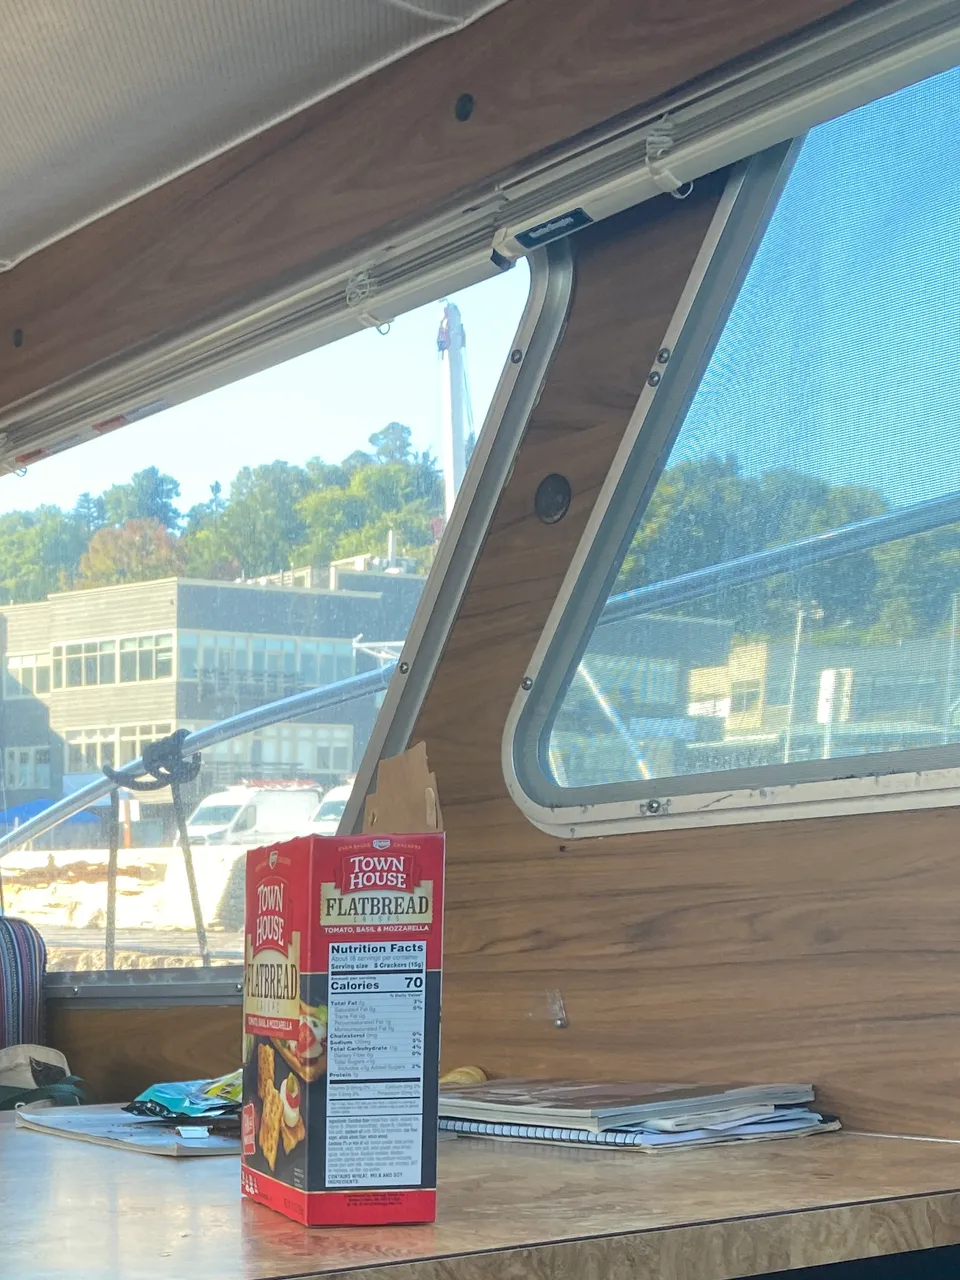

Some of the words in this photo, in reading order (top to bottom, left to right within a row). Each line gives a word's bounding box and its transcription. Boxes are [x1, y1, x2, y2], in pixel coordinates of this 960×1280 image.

[350, 856, 405, 873] TOWN
[349, 872, 407, 889] HOUSE
[258, 883, 284, 914] TOWN
[325, 895, 429, 916] FLATBREAD
[256, 915, 285, 947] HOUSE
[331, 944, 386, 954] Nutrition
[390, 943, 424, 952] Facts
[247, 964, 298, 1000] FLATBREAD
[331, 980, 380, 991] Calories
[404, 977, 423, 988] 70
